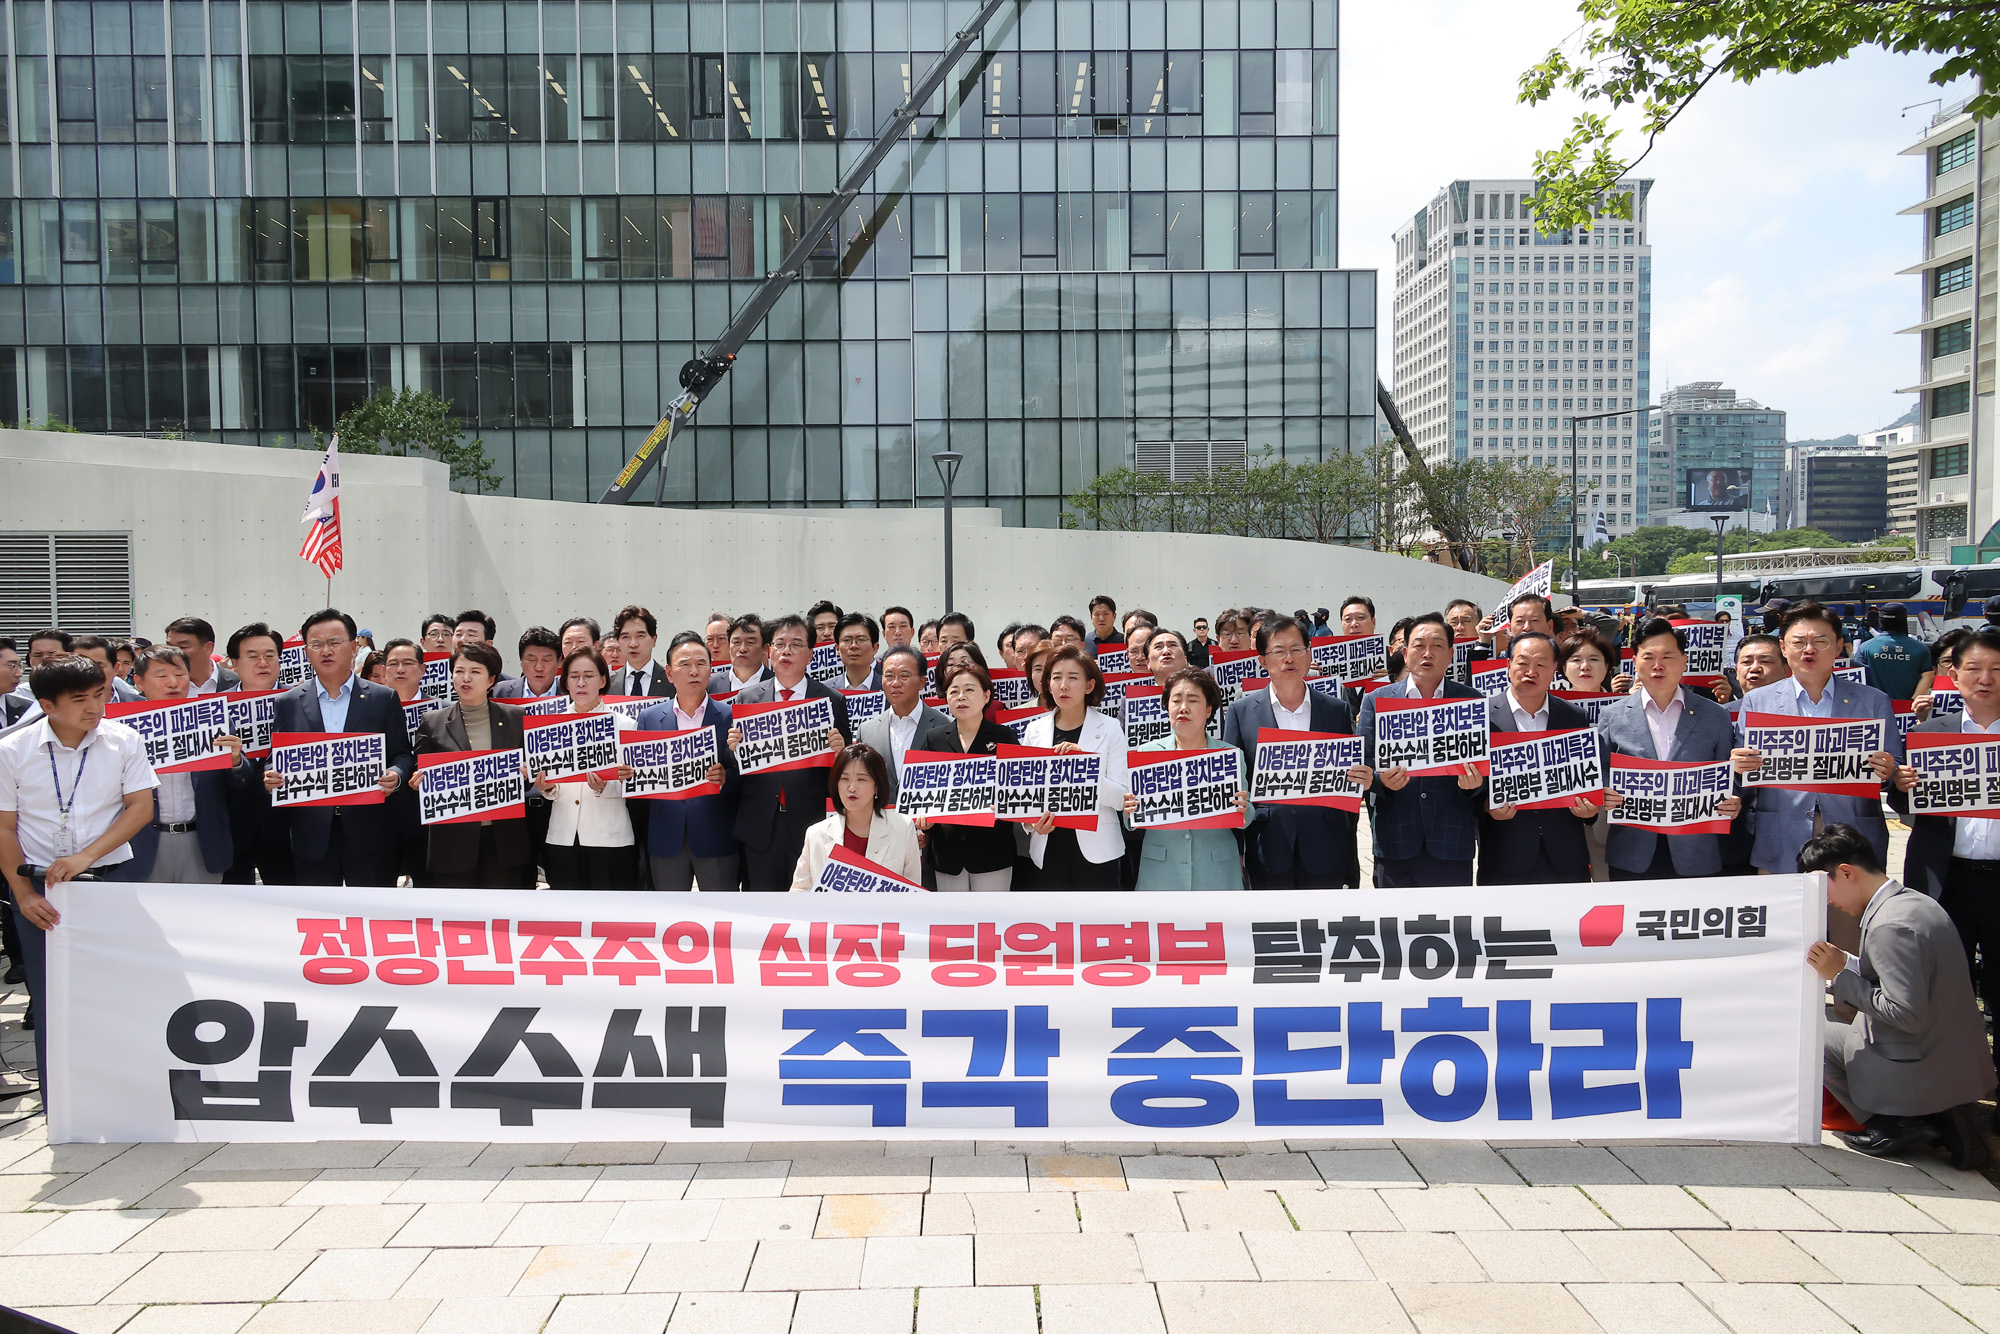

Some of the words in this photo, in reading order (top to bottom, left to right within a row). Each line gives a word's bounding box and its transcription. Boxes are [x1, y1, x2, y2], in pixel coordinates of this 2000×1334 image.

[1349, 637, 1384, 659] 파괴특검
[1873, 653, 1911, 661] POLICE
[1217, 659, 1257, 686] 야당탄압
[170, 700, 225, 733] 파괴특검
[736, 713, 782, 743] 야당탄압
[785, 701, 831, 733] 정치보복
[1379, 711, 1429, 741] 야당탄압
[1432, 701, 1486, 734] 정치보복
[527, 724, 573, 754] 야당탄압
[575, 716, 615, 745] 정치보복
[623, 741, 668, 769] 야당탄압
[670, 729, 715, 763] 정치보복
[1378, 739, 1429, 769] 압수수색
[1432, 730, 1487, 763] 중단하라
[1748, 729, 1811, 755] 민주주의
[1814, 723, 1880, 754] 파괴특검
[276, 744, 328, 773] 야당탄압
[332, 737, 383, 767] 정치보복
[529, 748, 574, 778] 압수수색
[577, 741, 617, 770] 중단하라
[739, 737, 785, 770] 압수수색
[1258, 743, 1311, 771] 야당탄압
[1314, 738, 1362, 768] 정치보복
[1490, 743, 1540, 776] 민주주의
[1542, 731, 1597, 766] 파괴특검
[1911, 747, 1980, 779] 민주주의
[332, 763, 384, 793] 중단하라
[422, 762, 470, 793] 야당탄압
[473, 752, 520, 783] 정치보복
[903, 763, 950, 790] 야당탄압
[953, 760, 996, 787] 정치보복
[998, 759, 1047, 787] 야당탄압
[1050, 757, 1100, 785] 정치보복
[1131, 762, 1182, 796] 야당탄압
[1185, 752, 1237, 786] 정치보복
[1255, 770, 1307, 797] 압수수색
[1492, 771, 1542, 804] 당원명부
[1545, 761, 1599, 795] 절대사수
[1612, 771, 1668, 796] 민주주의
[1672, 764, 1730, 796] 파괴특검
[423, 787, 471, 820] 압수수색
[474, 777, 522, 809] 중단하라
[900, 789, 947, 814] 압수수색
[950, 785, 995, 812] 중단하라
[997, 787, 1045, 814] 압수수색
[1048, 785, 1098, 812] 중단하라
[1187, 781, 1239, 816] 중단하라
[1912, 778, 1981, 808] 당원명부
[1636, 904, 1767, 941] 국민의힘
[297, 917, 735, 987] 정당민주주의
[758, 921, 905, 987] 심장
[929, 921, 1227, 987] 당원명부
[1251, 915, 1558, 983] 탈취하는
[165, 999, 727, 1128] 압수수색
[779, 1003, 1061, 1128] 즉각
[1107, 996, 1694, 1128] 중단하라
